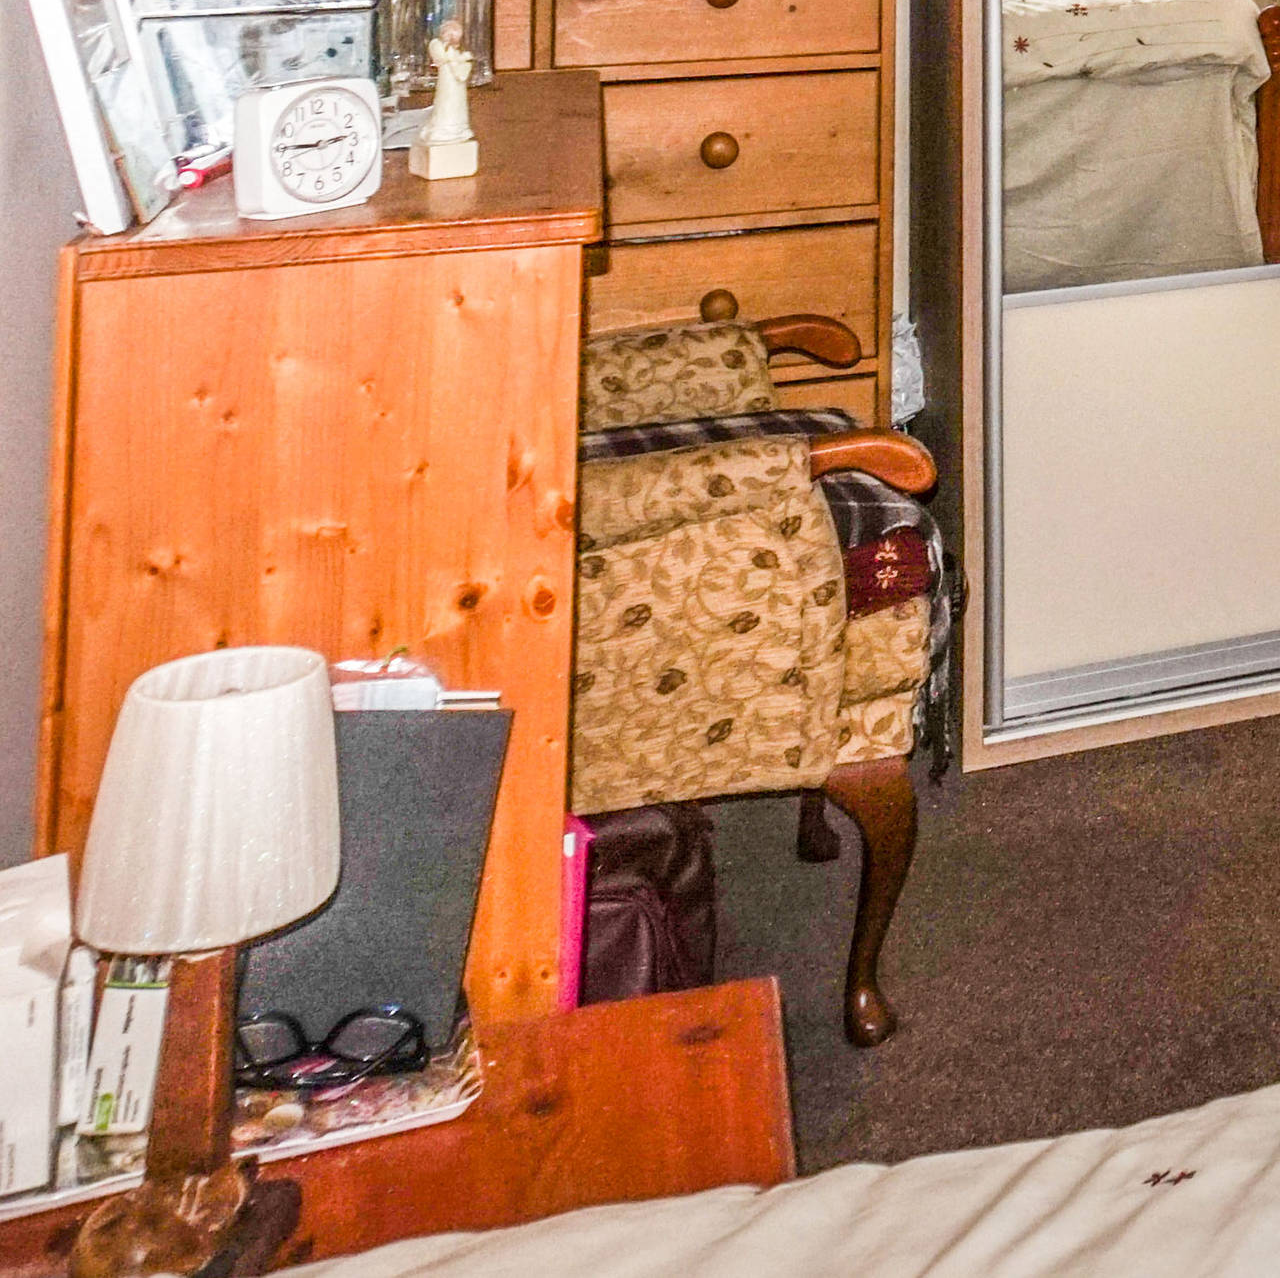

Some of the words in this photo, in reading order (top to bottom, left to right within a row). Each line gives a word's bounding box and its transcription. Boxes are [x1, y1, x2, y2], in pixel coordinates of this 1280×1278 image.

[311, 98, 324, 115] 12
[343, 113, 353, 129] 2
[348, 131, 359, 147] 3
[282, 161, 292, 177] 8
[314, 175, 325, 191] 6
